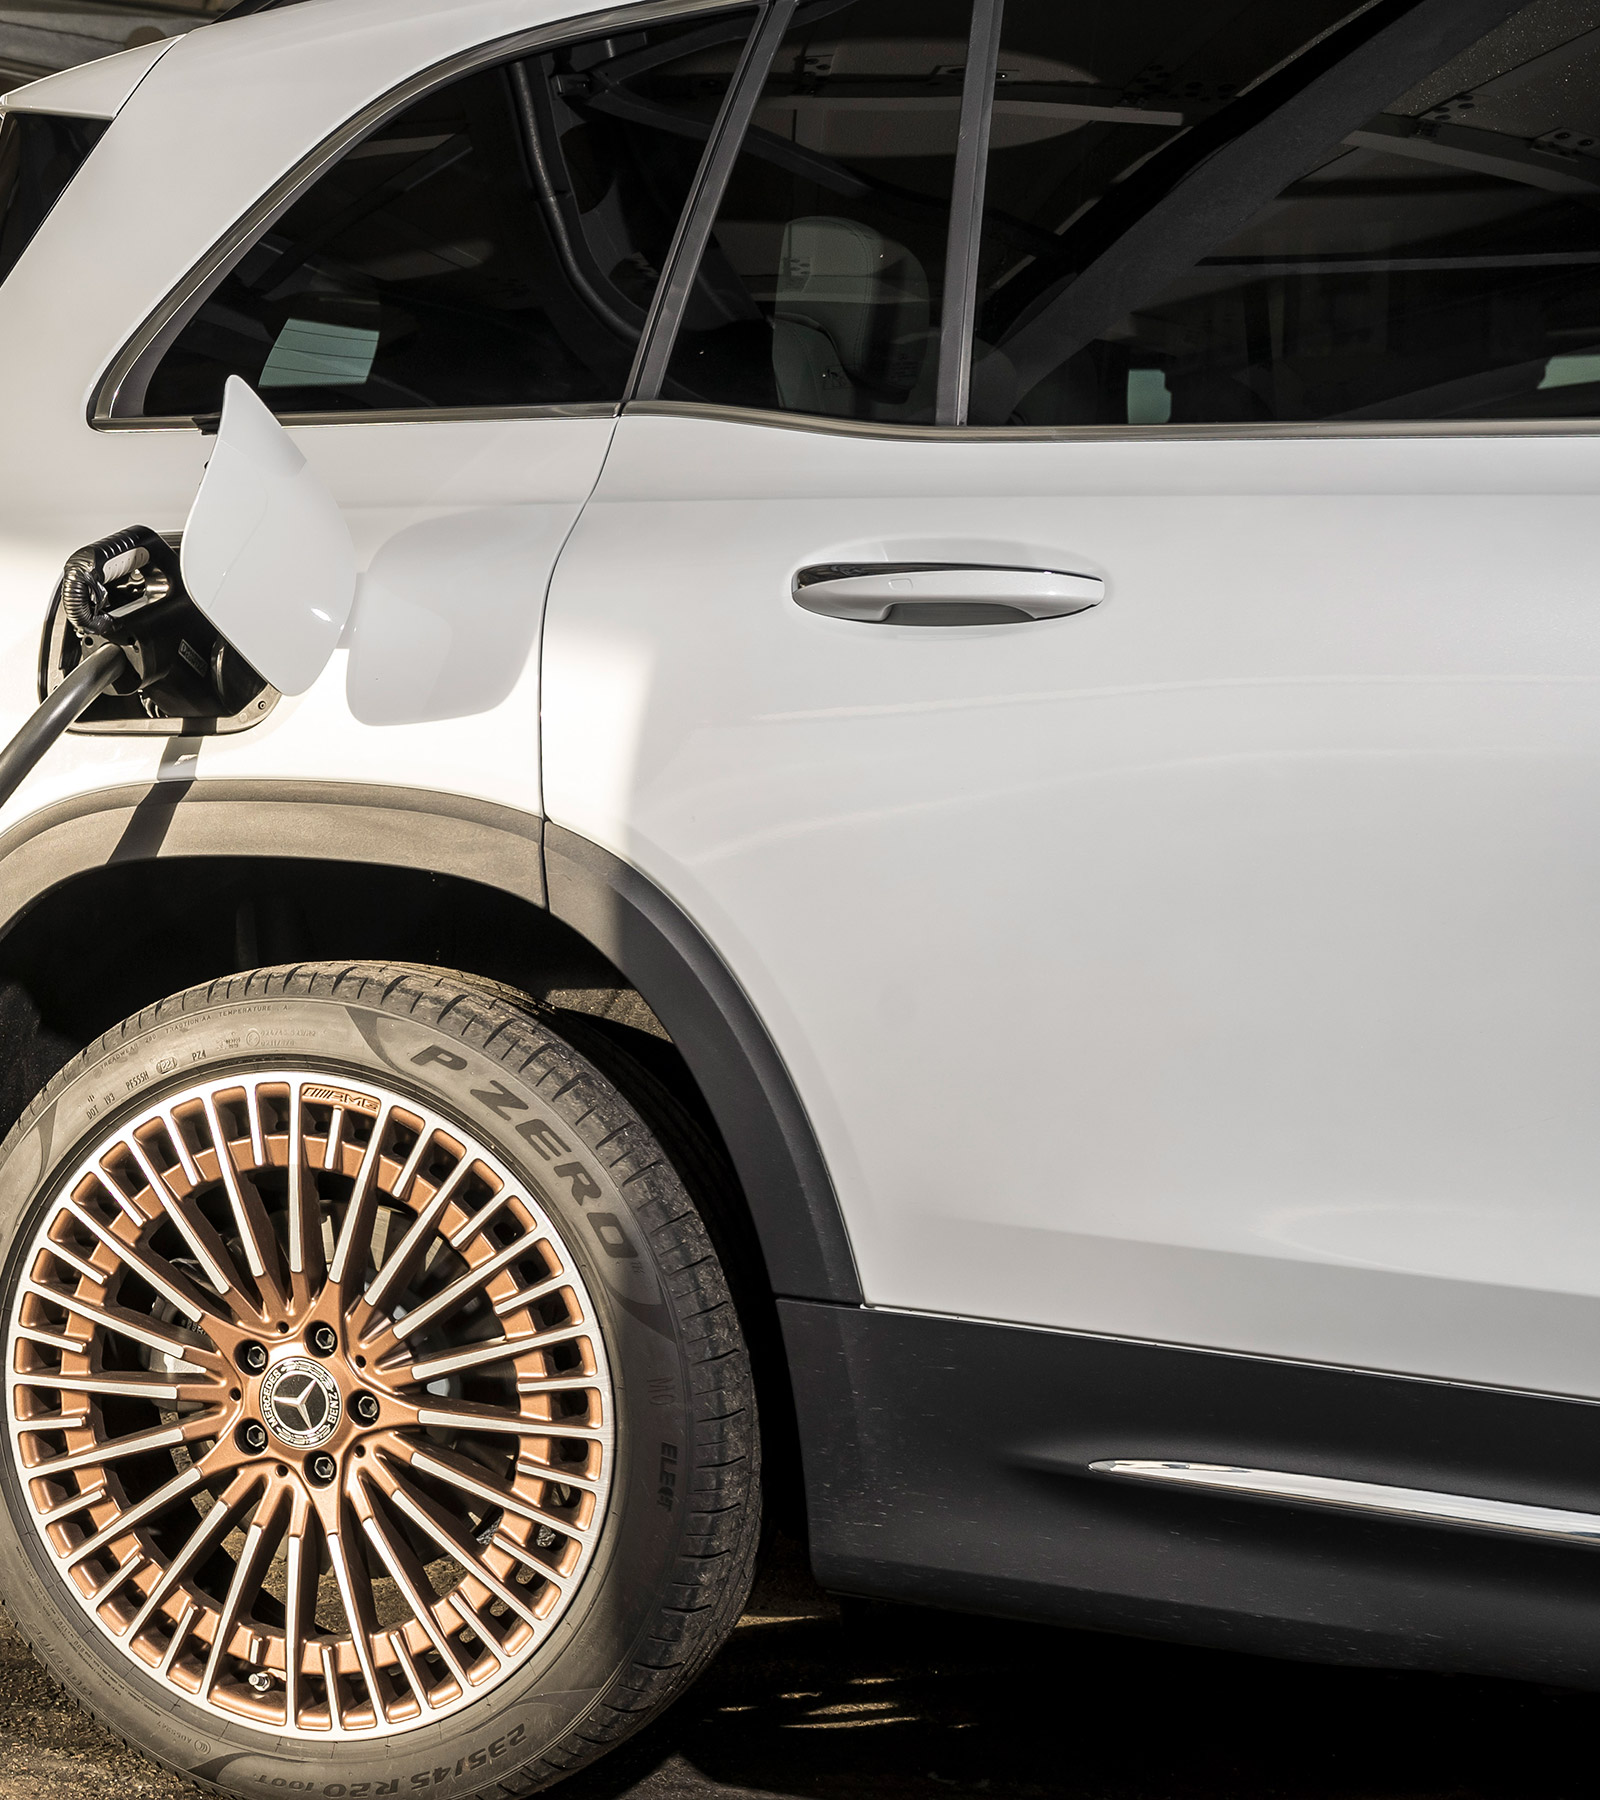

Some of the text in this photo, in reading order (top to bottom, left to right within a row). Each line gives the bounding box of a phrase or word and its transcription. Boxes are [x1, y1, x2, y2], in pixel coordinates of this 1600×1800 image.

[100, 1044, 138, 1070] TREADWEAR
[165, 1018, 199, 1034] TRACTION
[219, 1004, 271, 1018] TEMPERATURE
[86, 1104, 100, 1121] DOT
[104, 1092, 115, 1106] 193
[191, 1050, 206, 1062] PZ4
[326, 1088, 380, 1112] AMG
[410, 1044, 640, 1258] P ZERO
[262, 1369, 281, 1428] MERCEDES
[327, 1391, 339, 1425] BENZ
[255, 1723, 528, 1799] 235/45 R20 100T
